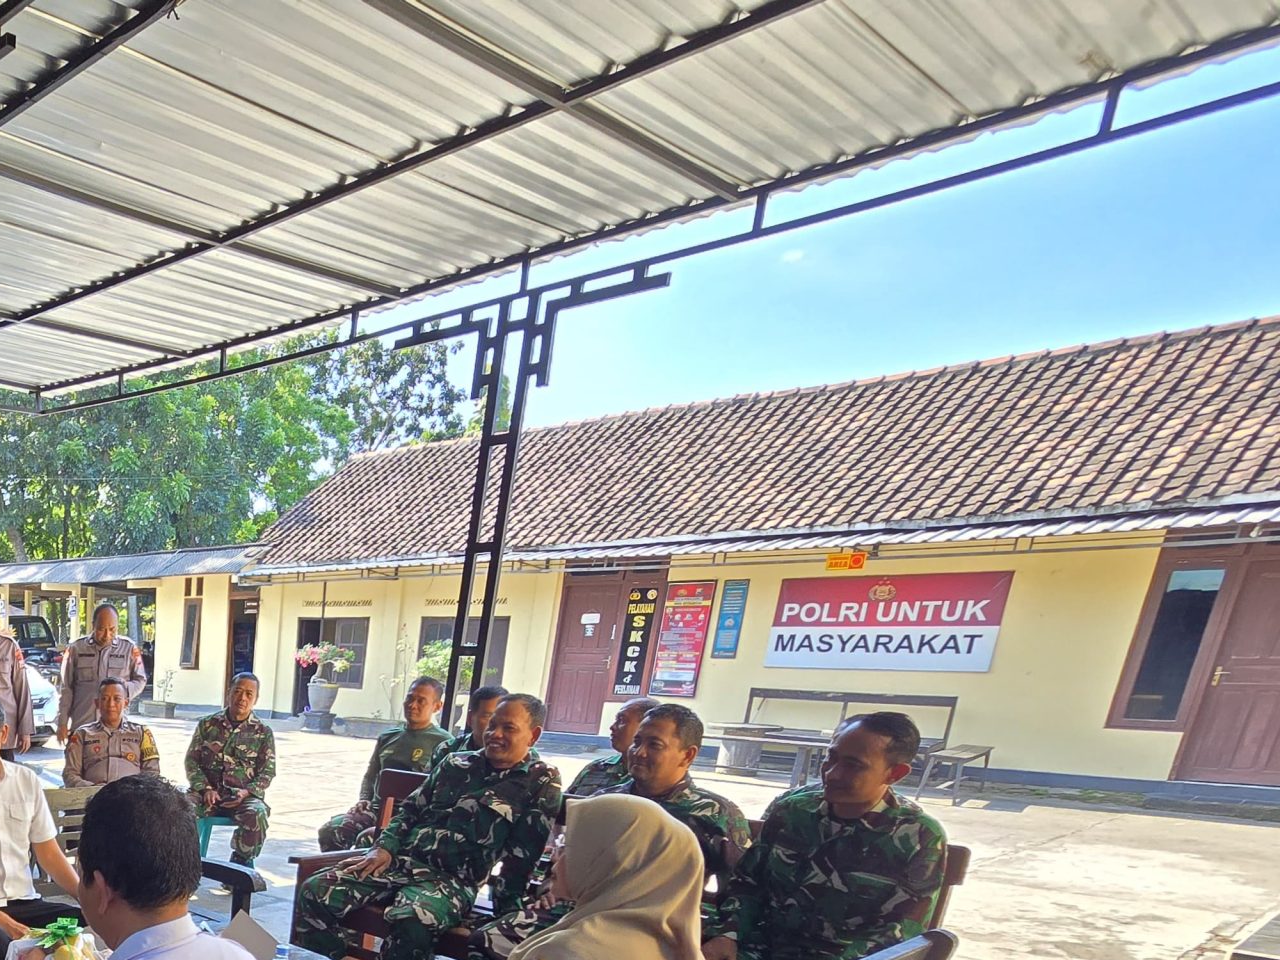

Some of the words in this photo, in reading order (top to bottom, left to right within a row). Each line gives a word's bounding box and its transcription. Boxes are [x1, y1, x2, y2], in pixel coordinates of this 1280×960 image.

[628, 604, 655, 614] PELAYANAN
[780, 602, 868, 622] POLRI
[876, 599, 991, 622] UNTUK
[774, 633, 983, 655] MASYARAKAT
